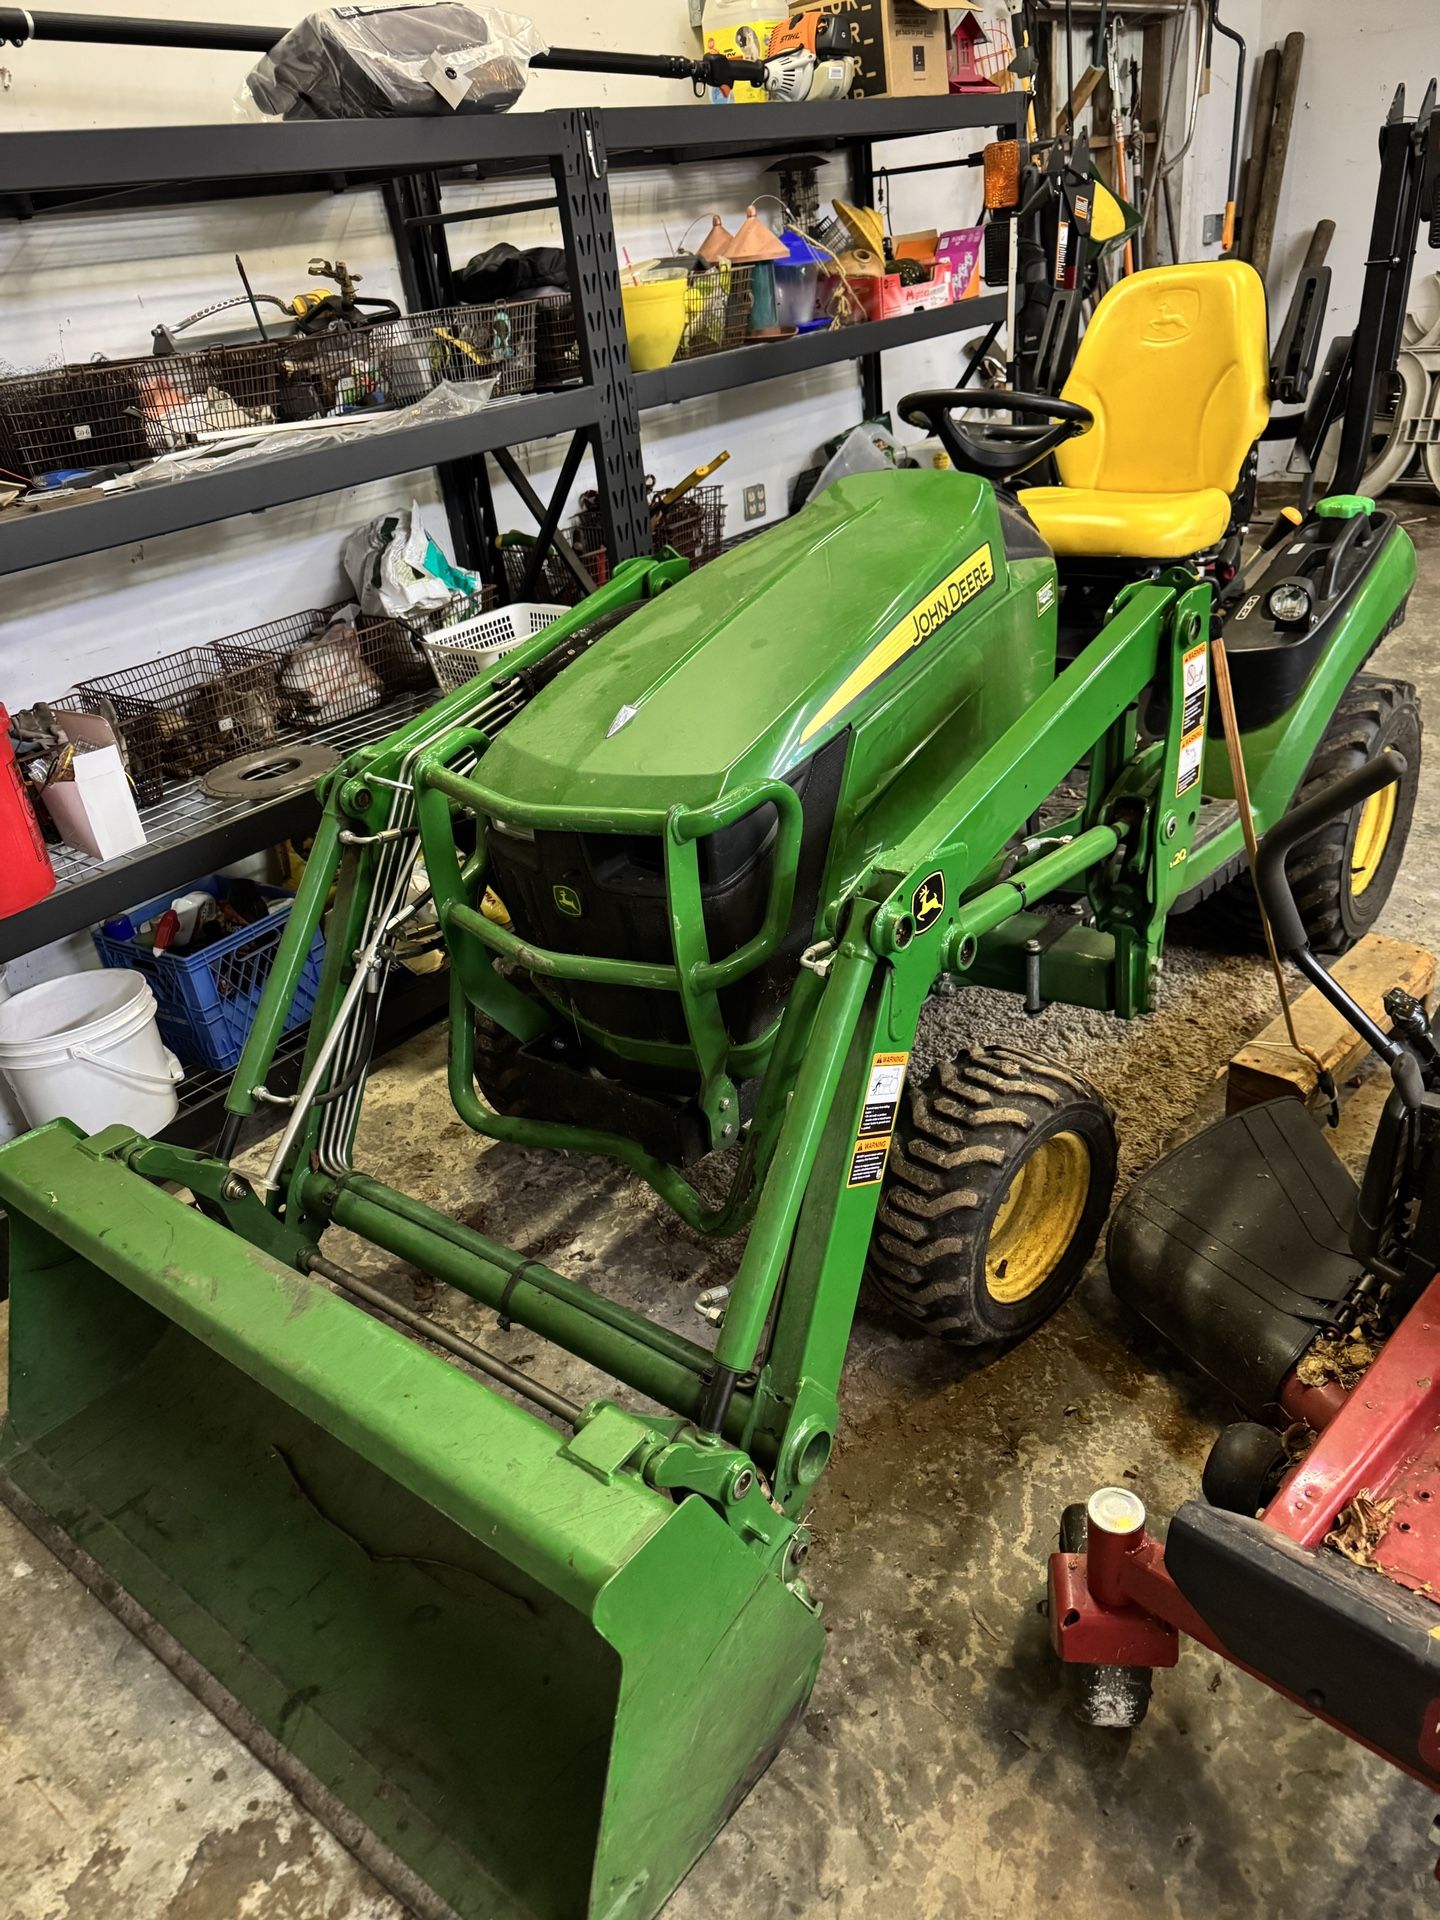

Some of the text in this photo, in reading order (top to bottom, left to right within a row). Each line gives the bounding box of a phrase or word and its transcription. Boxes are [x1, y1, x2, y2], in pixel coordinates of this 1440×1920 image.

[779, 32, 800, 43] STIHL
[913, 595, 949, 643] JOHN
[947, 561, 990, 608] DEERE
[1187, 644, 1206, 660] WARNING
[1185, 728, 1203, 746] WARNING
[883, 1056, 905, 1064] WARNING
[864, 1141, 887, 1149] WARNING
